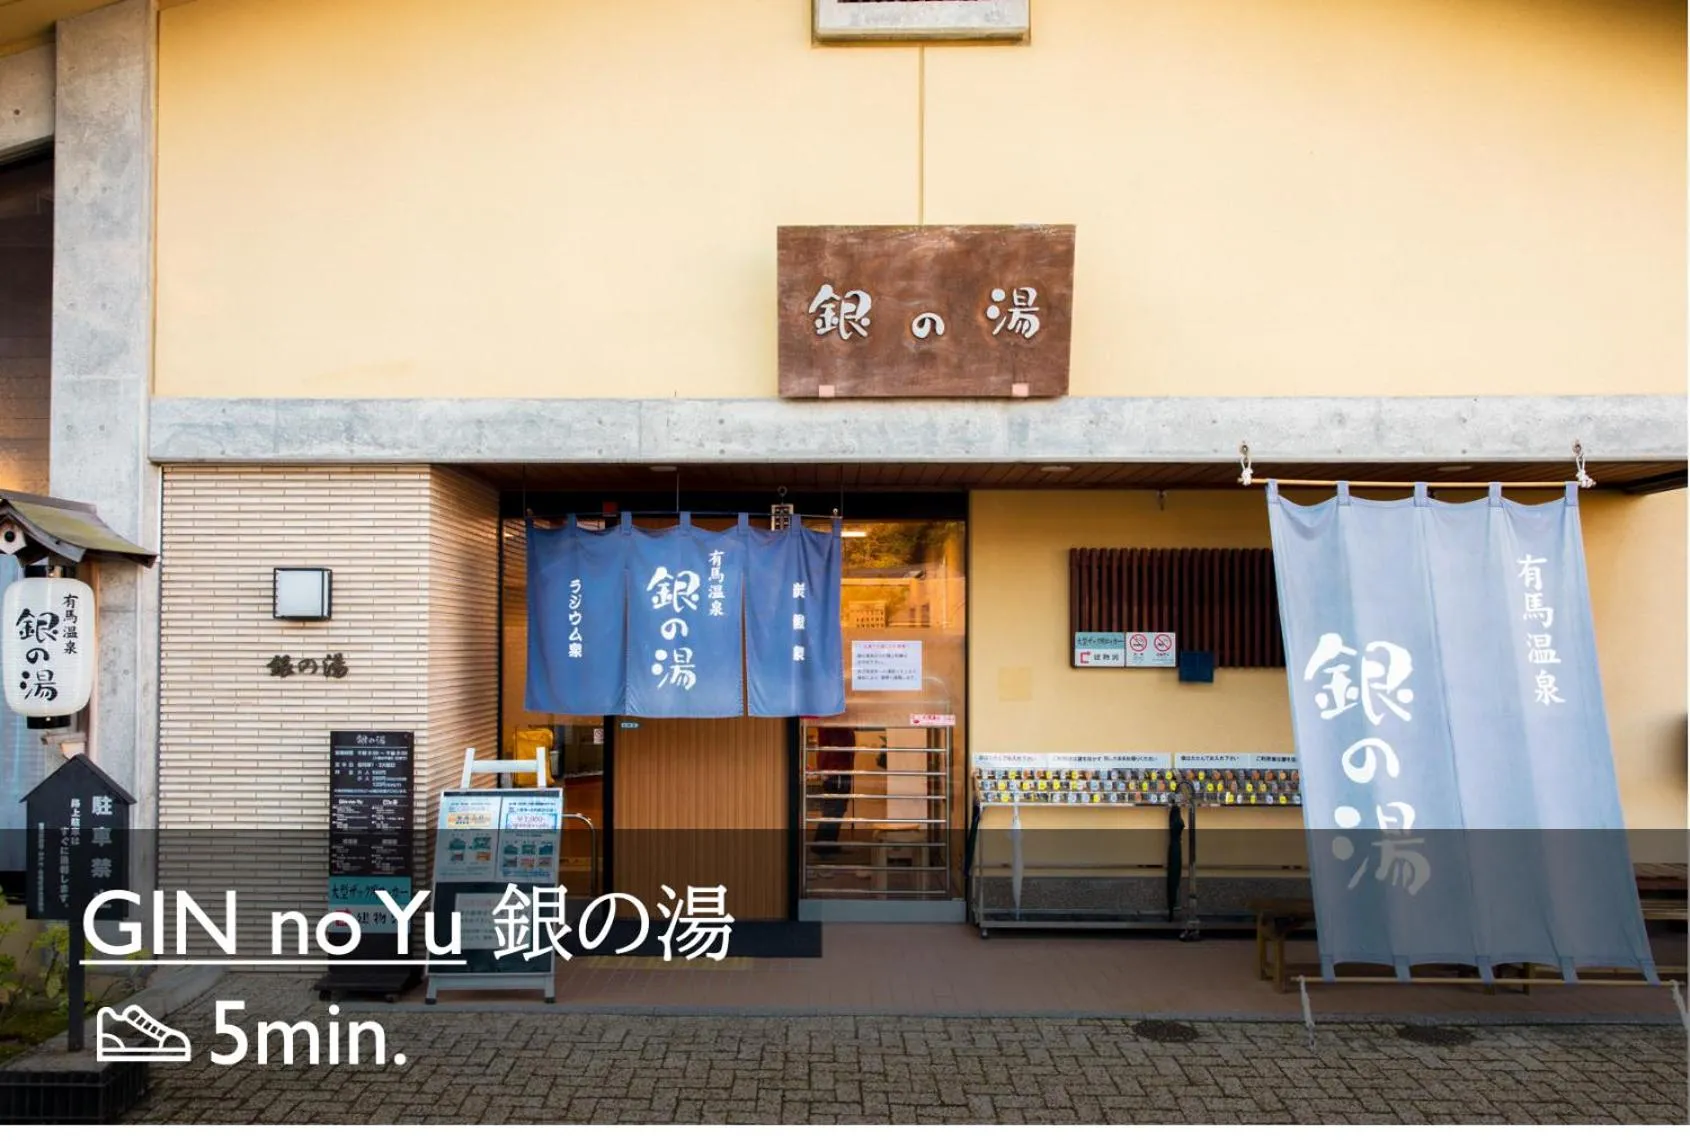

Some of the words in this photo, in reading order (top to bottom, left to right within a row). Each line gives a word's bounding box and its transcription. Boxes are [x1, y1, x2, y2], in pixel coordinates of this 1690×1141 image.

[808, 284, 1040, 340] 銀の湯
[568, 579, 583, 658] ラジウム泉
[707, 549, 726, 617] 有馬温泉
[15, 608, 60, 702] 銀の湯
[63, 594, 79, 655] 有馬温泉
[646, 566, 701, 691] 銀の湯
[1516, 553, 1566, 706] 有馬温泉
[266, 652, 349, 679] 銀の湯
[1303, 633, 1432, 896] 銀の湯
